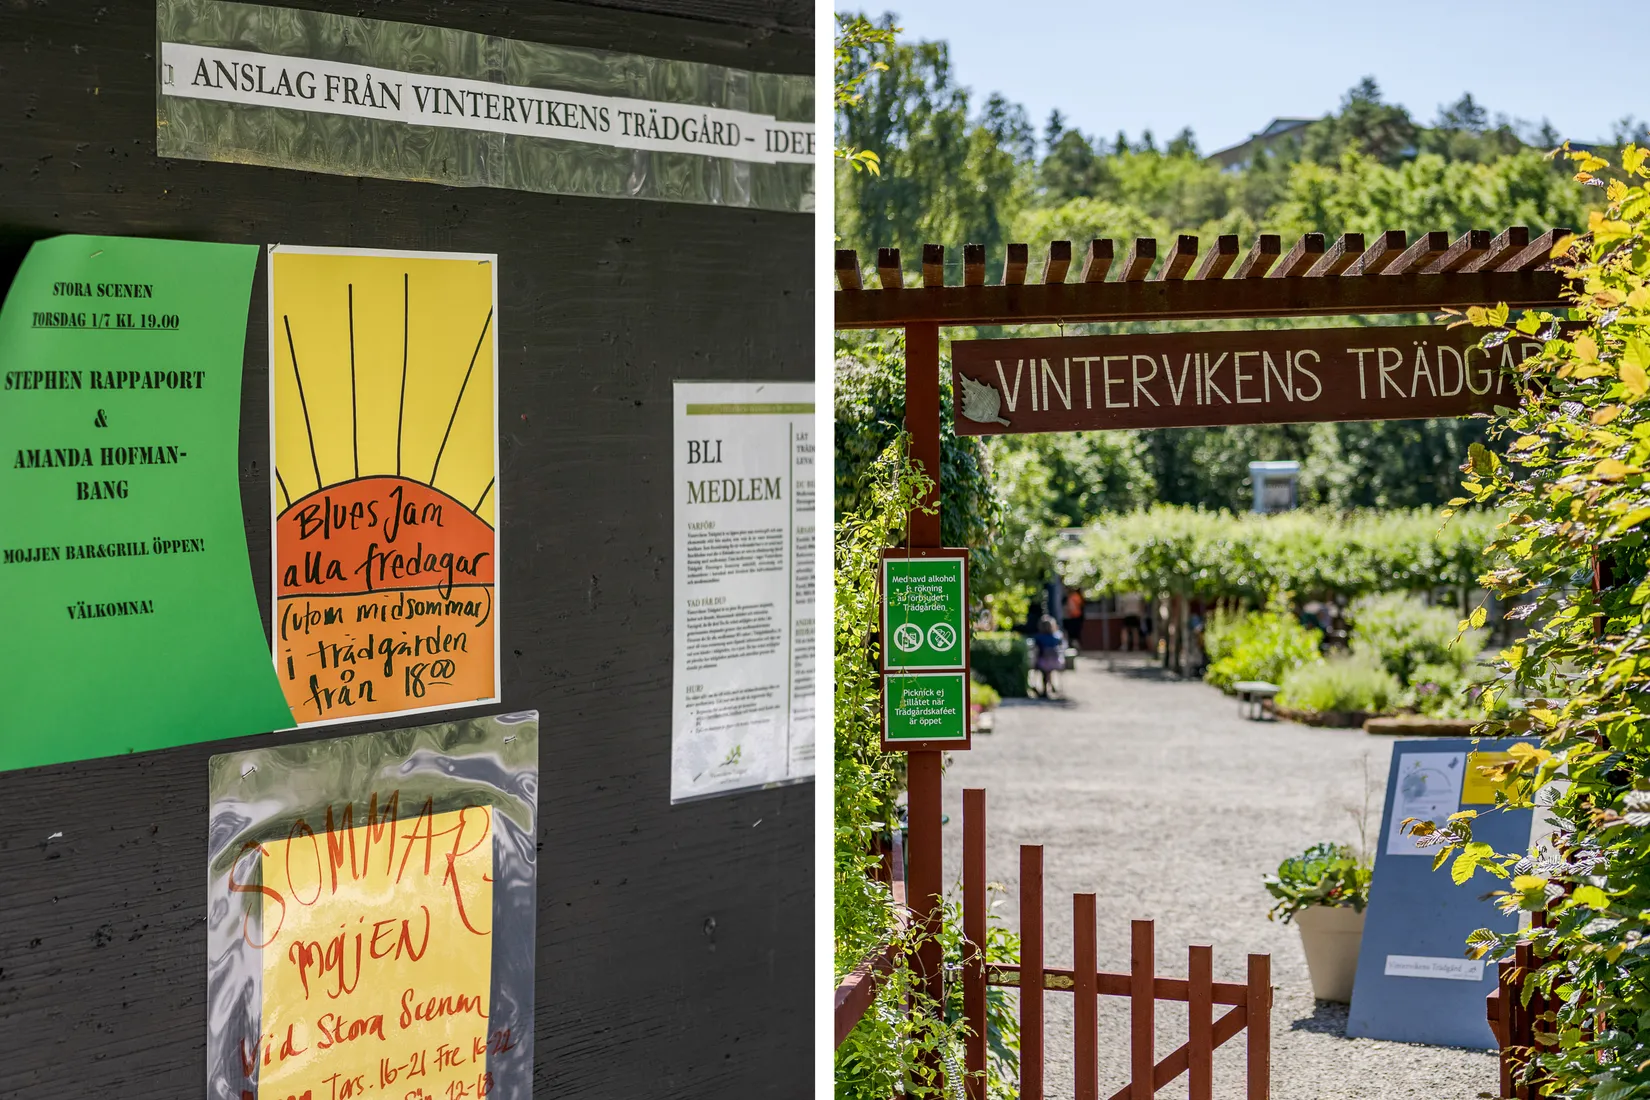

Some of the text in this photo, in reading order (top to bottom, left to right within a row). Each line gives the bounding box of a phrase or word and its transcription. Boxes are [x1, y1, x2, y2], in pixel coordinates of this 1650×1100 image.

[190, 57, 317, 100] ANSLAG
[323, 74, 402, 111] FRÅN
[411, 84, 611, 132] VINTERVIKENS
[617, 109, 741, 147] TRÄDGÅRD
[53, 282, 153, 299] STORA SCENEN
[32, 312, 180, 329] TORSDAG 1/7 KL 19.00
[5, 370, 206, 391] STEPHEN RAPPAPORT
[995, 340, 1556, 412] VINTERVIKENS TRÄDGÅR
[94, 408, 108, 428] &
[14, 446, 188, 469] AMANDA HOFMAN-
[687, 439, 723, 464] BLI
[76, 480, 129, 501] BANG
[686, 476, 782, 504] MEDLEM
[293, 485, 444, 544] Blues Jam
[3, 536, 206, 565] MOJJEN BAR&GRILL ÖPPEN!
[283, 541, 491, 600] alla fredagar
[928, 574, 956, 583] alkohol
[914, 584, 943, 593] rökning
[67, 599, 155, 620] VÄLKOMNA!
[280, 586, 491, 642] (utom midsommar)
[902, 603, 946, 613] Trädgården
[285, 624, 468, 681] i trädgården
[302, 669, 378, 716] från
[903, 688, 944, 698] Picknick ej
[903, 698, 945, 706] tillåtet när
[894, 706, 956, 718] Trädgårdskaféet
[909, 717, 942, 726] är öppet
[316, 1011, 387, 1050] Stora
[379, 1049, 426, 1090] 16-21
[434, 1042, 467, 1073] Fre
